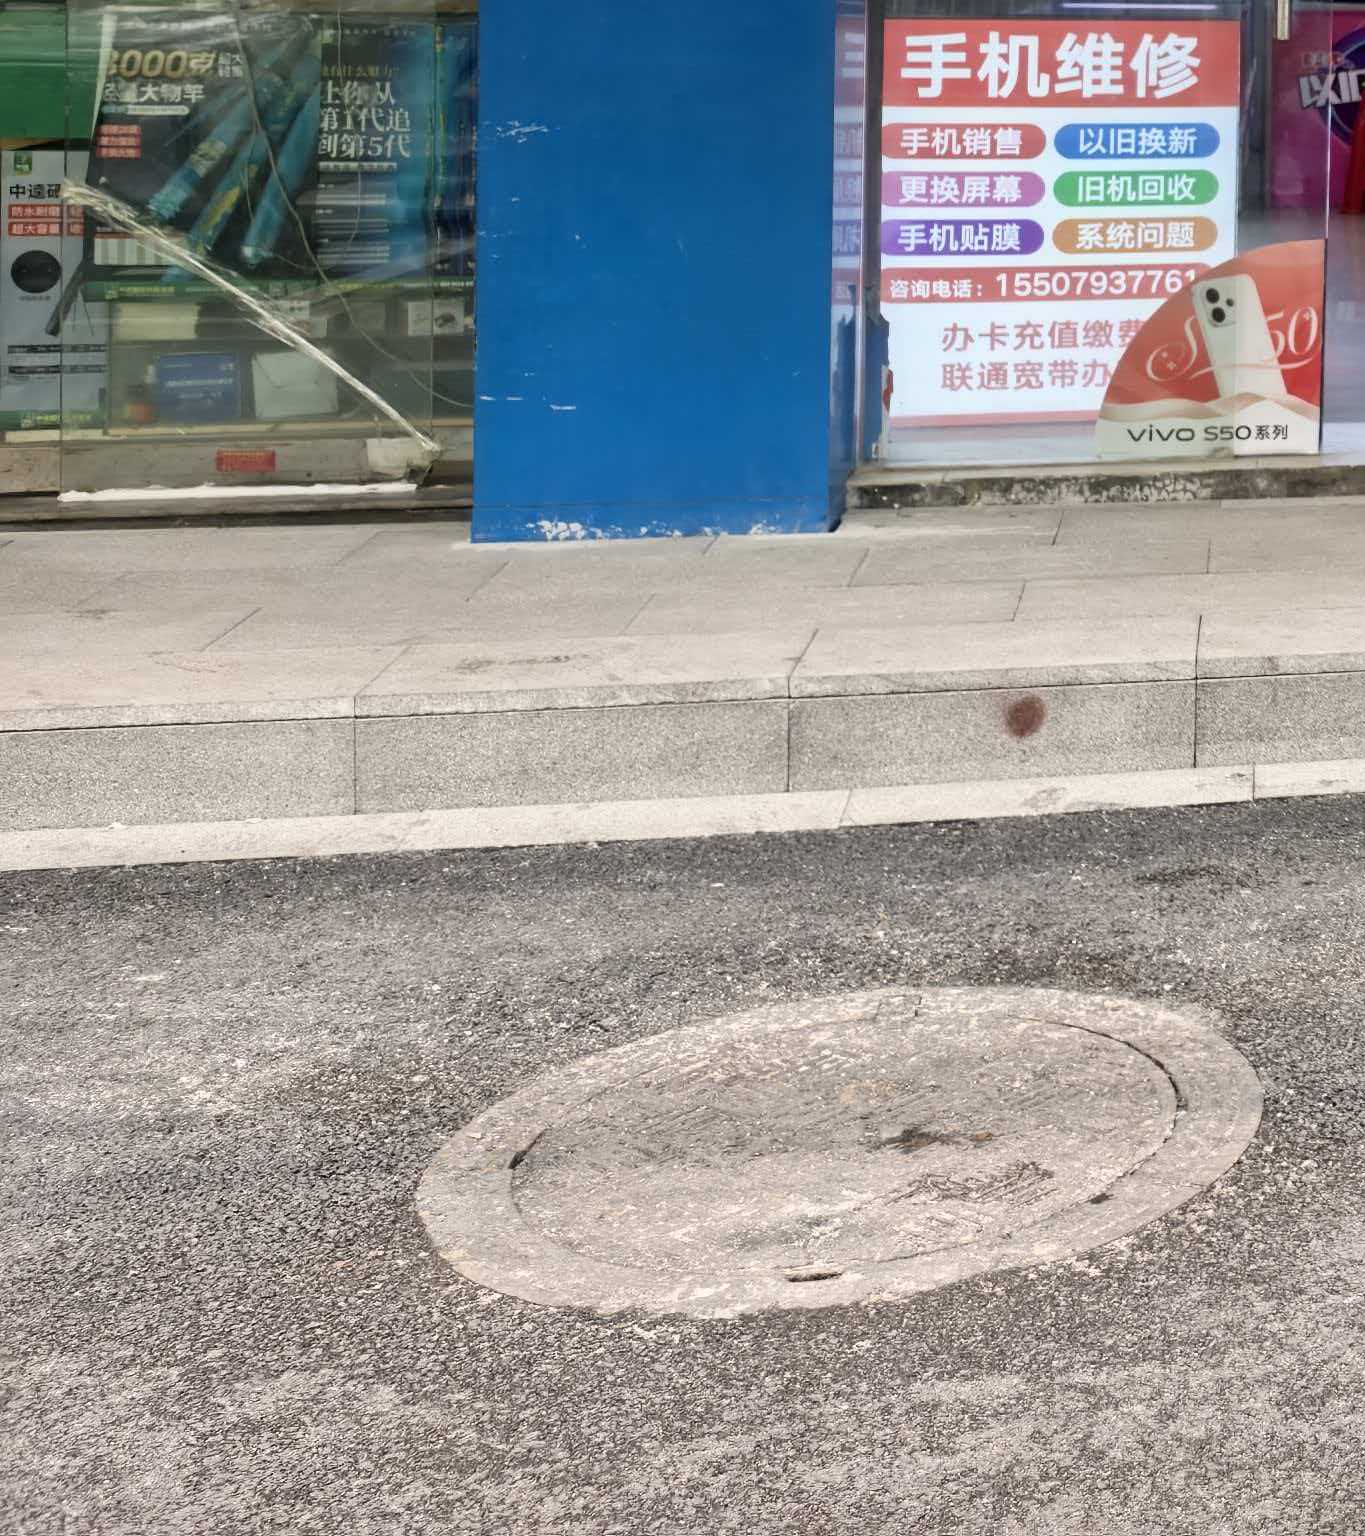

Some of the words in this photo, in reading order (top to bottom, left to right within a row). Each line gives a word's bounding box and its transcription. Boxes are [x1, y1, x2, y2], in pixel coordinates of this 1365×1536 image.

[900, 30, 1201, 100] 手机维修
[900, 126, 1023, 156] 手机销售
[1079, 126, 1198, 155] 以旧换新
[899, 175, 1023, 204] 更换屏幕
[1077, 173, 1197, 202] 旧机回收
[897, 222, 1022, 252] 手机贴膜
[1075, 221, 1195, 250] 系统问题
[1127, 424, 1196, 442] vivo
[1203, 425, 1252, 441] S50
[1254, 424, 1289, 441] 系列
